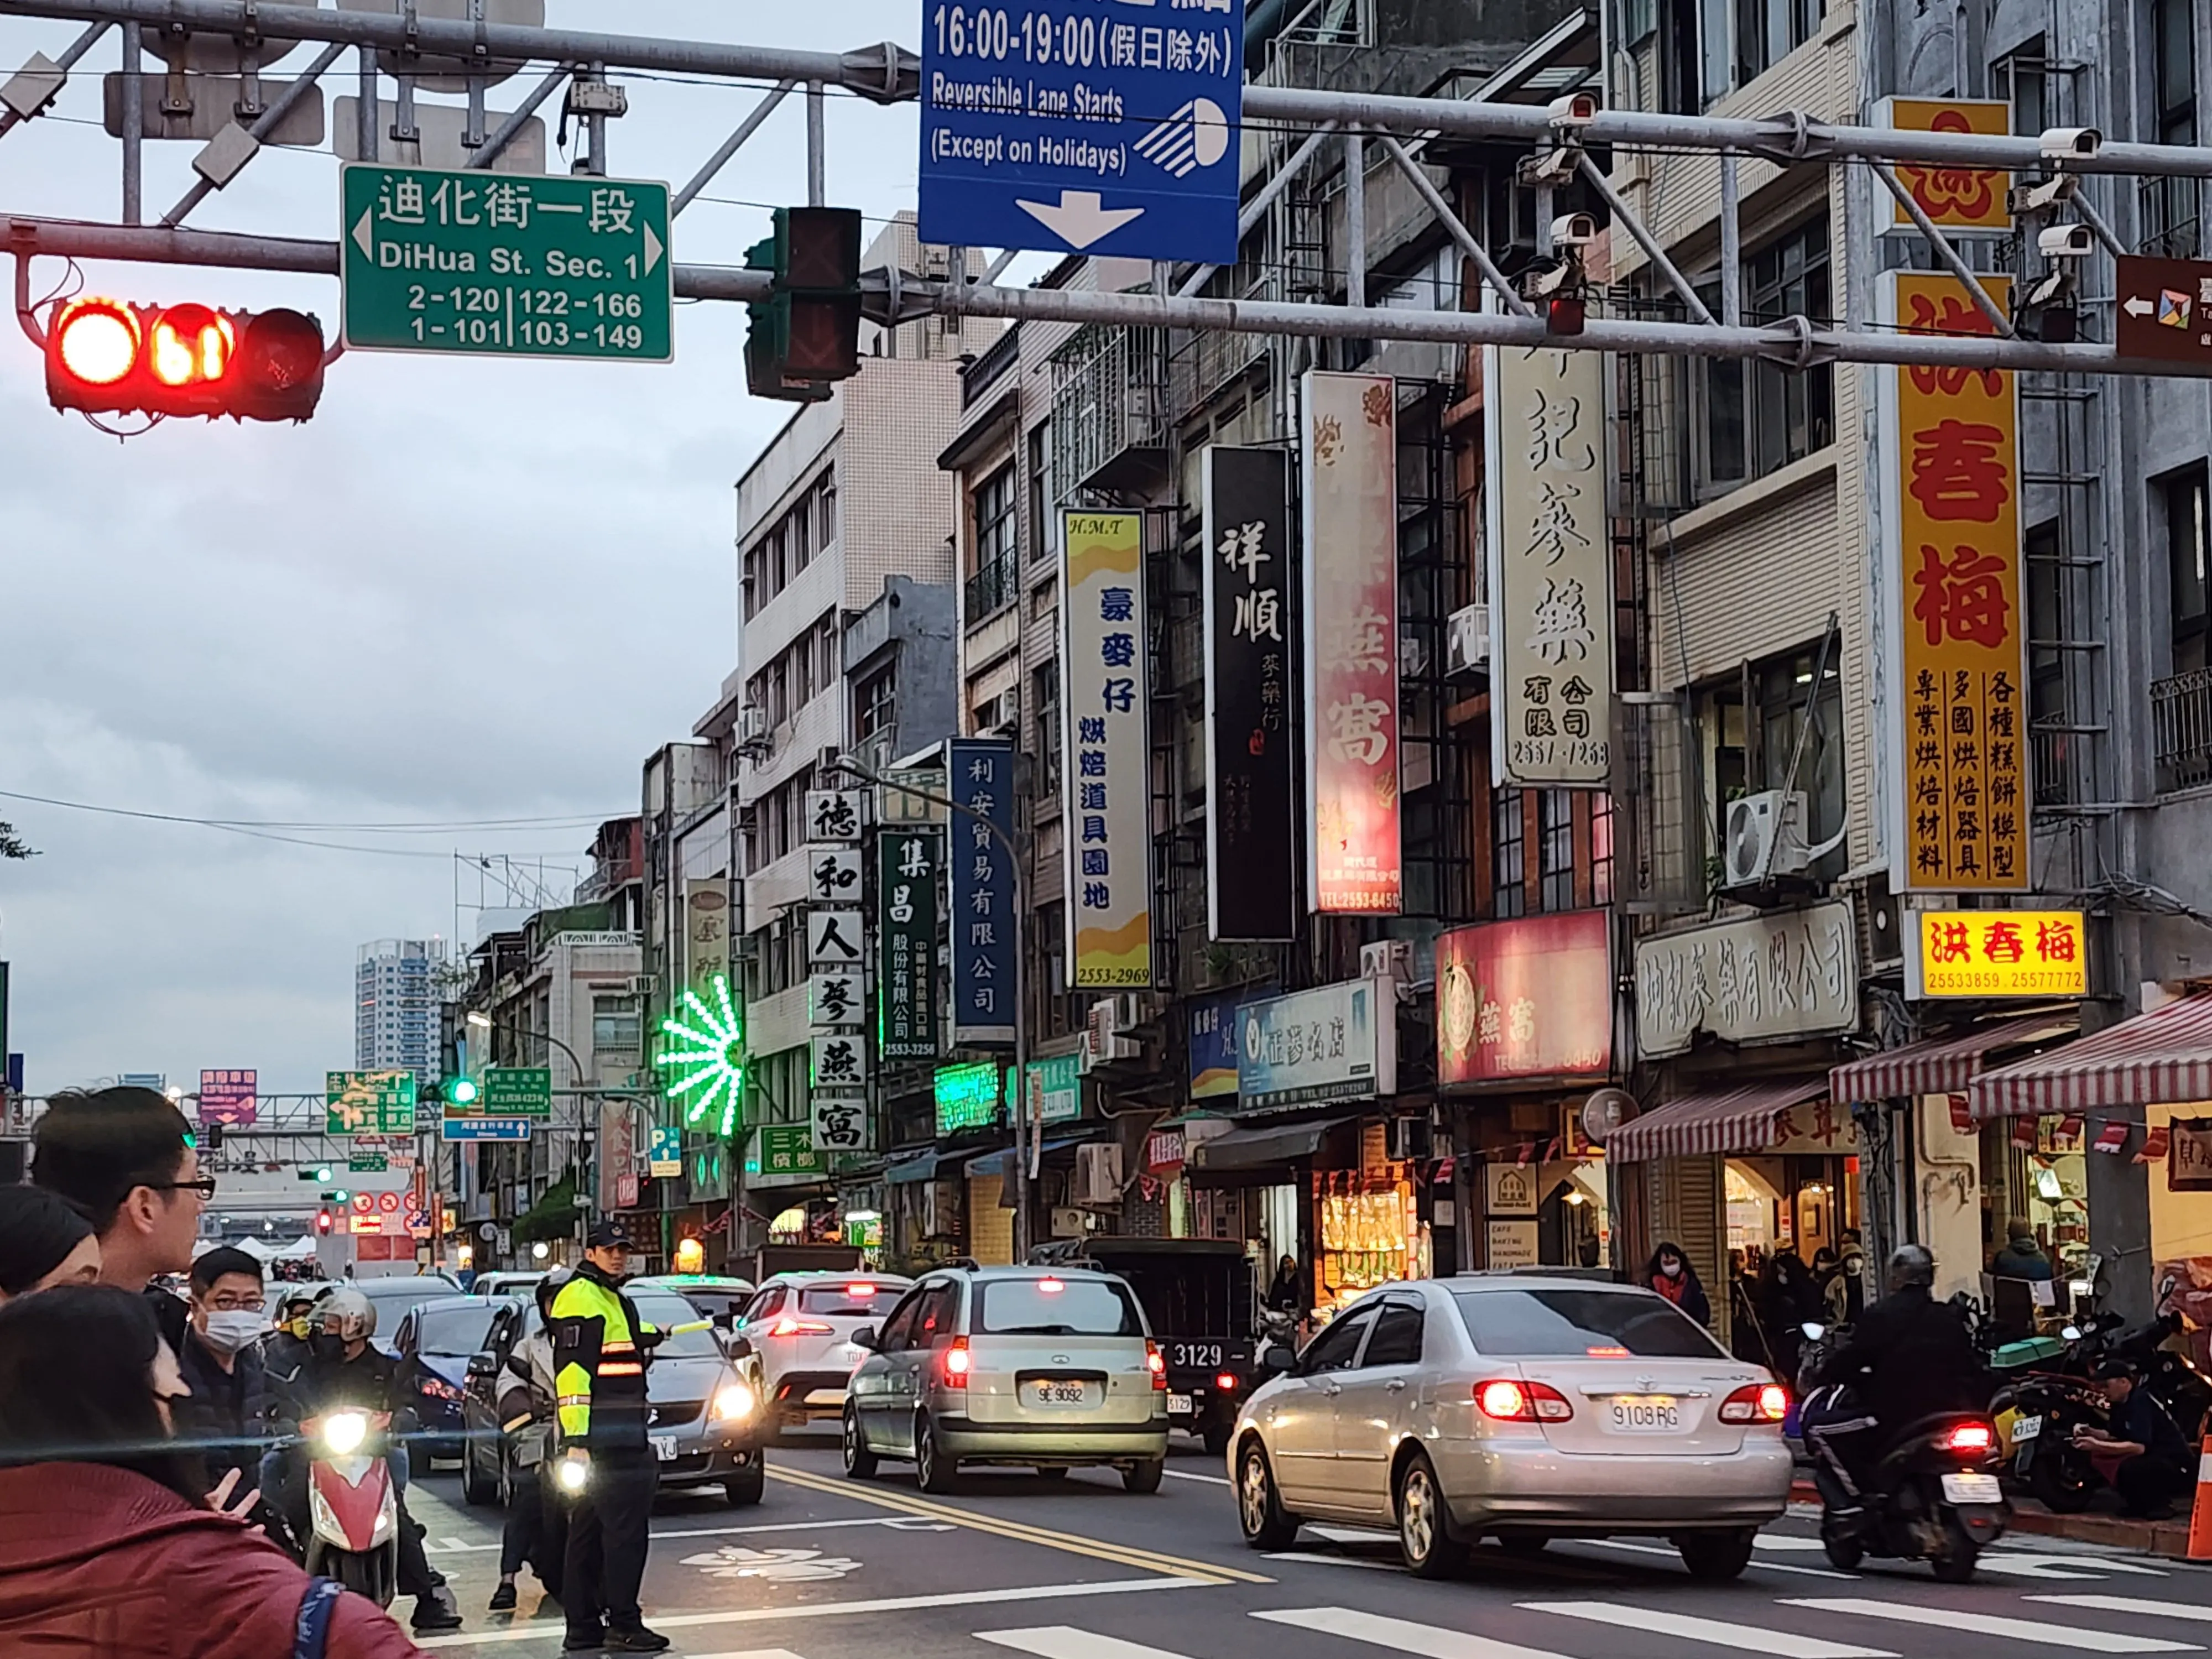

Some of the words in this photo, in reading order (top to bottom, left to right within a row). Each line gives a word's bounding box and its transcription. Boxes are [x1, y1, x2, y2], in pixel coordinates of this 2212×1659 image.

[932, 72, 1022, 116] Reversible
[1029, 80, 1068, 119] Lane
[1073, 83, 1123, 123] Starts
[931, 128, 1003, 166] (Except
[1009, 140, 1032, 163] on
[1039, 136, 1126, 177] Holidays)
[378, 174, 635, 235] 迪化街一段
[379, 241, 476, 272] DiHua
[490, 247, 531, 274] St.
[545, 251, 612, 279] Sec.
[624, 254, 637, 280] 1
[1908, 292, 2009, 648] 洪春梅
[1069, 518, 1124, 535] H.M.T
[1217, 520, 1282, 644] 祥順
[1100, 587, 1137, 713] 豪麥仔
[1079, 716, 1110, 910] 烘焙道具園地
[1950, 670, 1981, 878] 多國烘焙器具
[1988, 670, 2018, 878] 各種糕餅模型
[889, 839, 931, 924] 集昌
[969, 758, 996, 1013] 利安貿易有限公司
[813, 794, 863, 1147] 德和人蔘燕窩
[1078, 967, 1149, 984] 2553-2969
[1928, 973, 2000, 989] 25533859
[2011, 972, 2082, 988] 25577772
[1931, 920, 2077, 964] 洪春梅
[893, 933, 909, 1040] 股份有限公司
[1174, 1343, 1222, 1367] 3129
